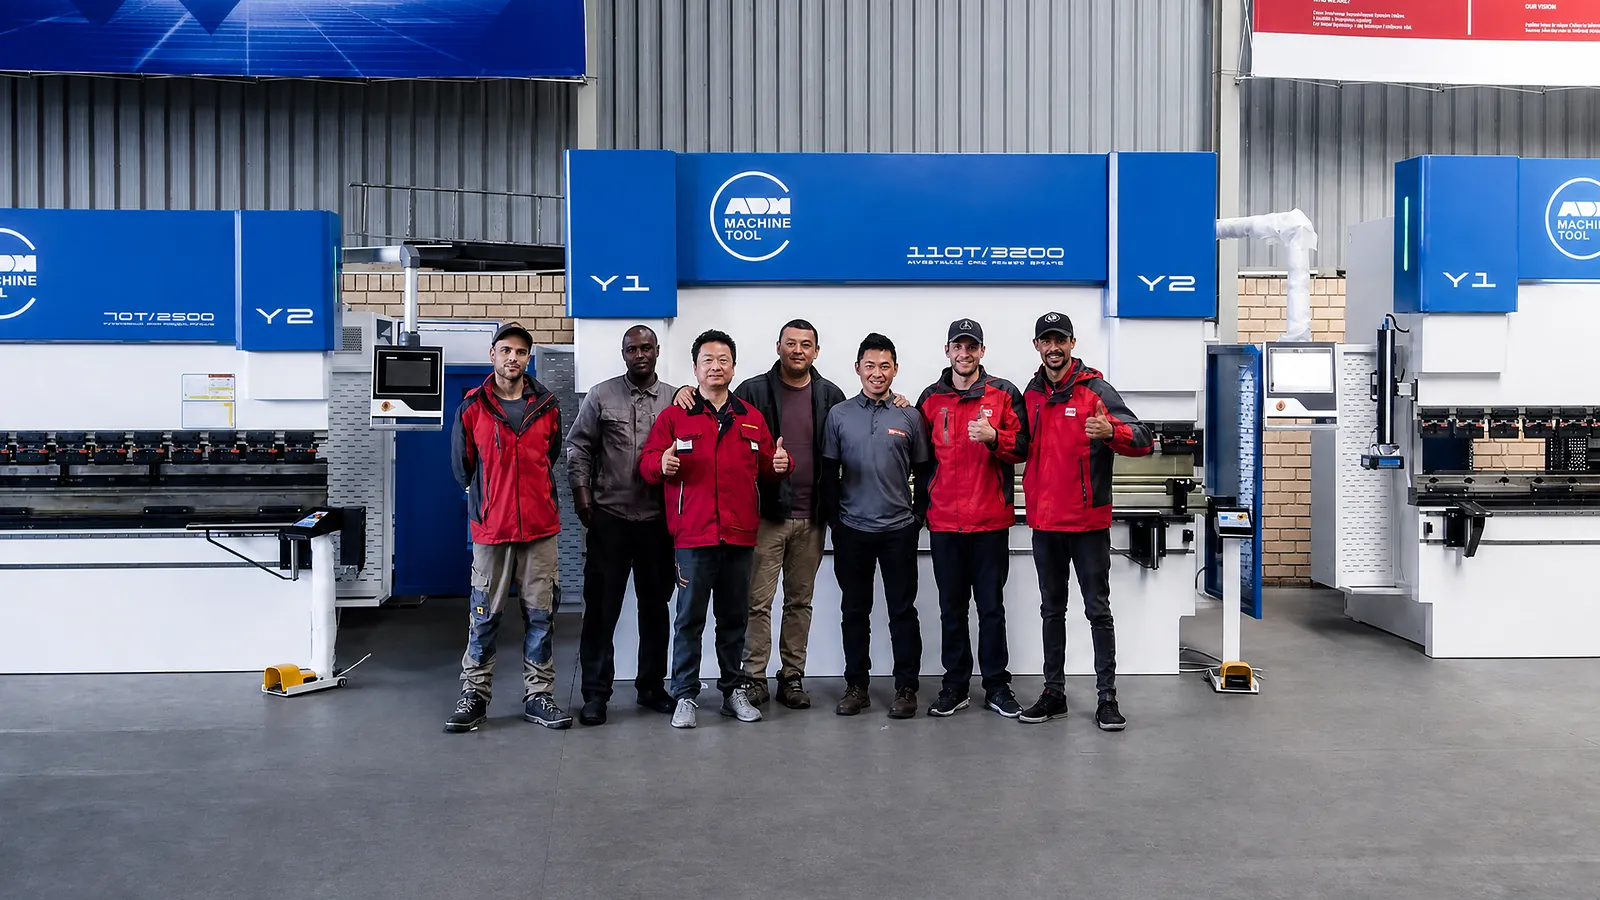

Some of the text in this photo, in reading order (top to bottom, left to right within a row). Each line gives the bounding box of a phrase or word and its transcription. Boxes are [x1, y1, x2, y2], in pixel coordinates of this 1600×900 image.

[724, 218, 792, 228] MACHINE
[1557, 219, 1600, 230] MACHI
[725, 230, 762, 241] TOOL
[1557, 230, 1590, 241] TOOL
[906, 246, 1065, 259] 110T/3200
[0, 254, 37, 273] DM
[0, 275, 37, 287] HINE
[589, 274, 650, 292] Y1
[1137, 274, 1196, 292] Y2
[1442, 271, 1497, 288] Y1
[103, 311, 215, 322] 70T/2500
[255, 307, 314, 325] Y2
